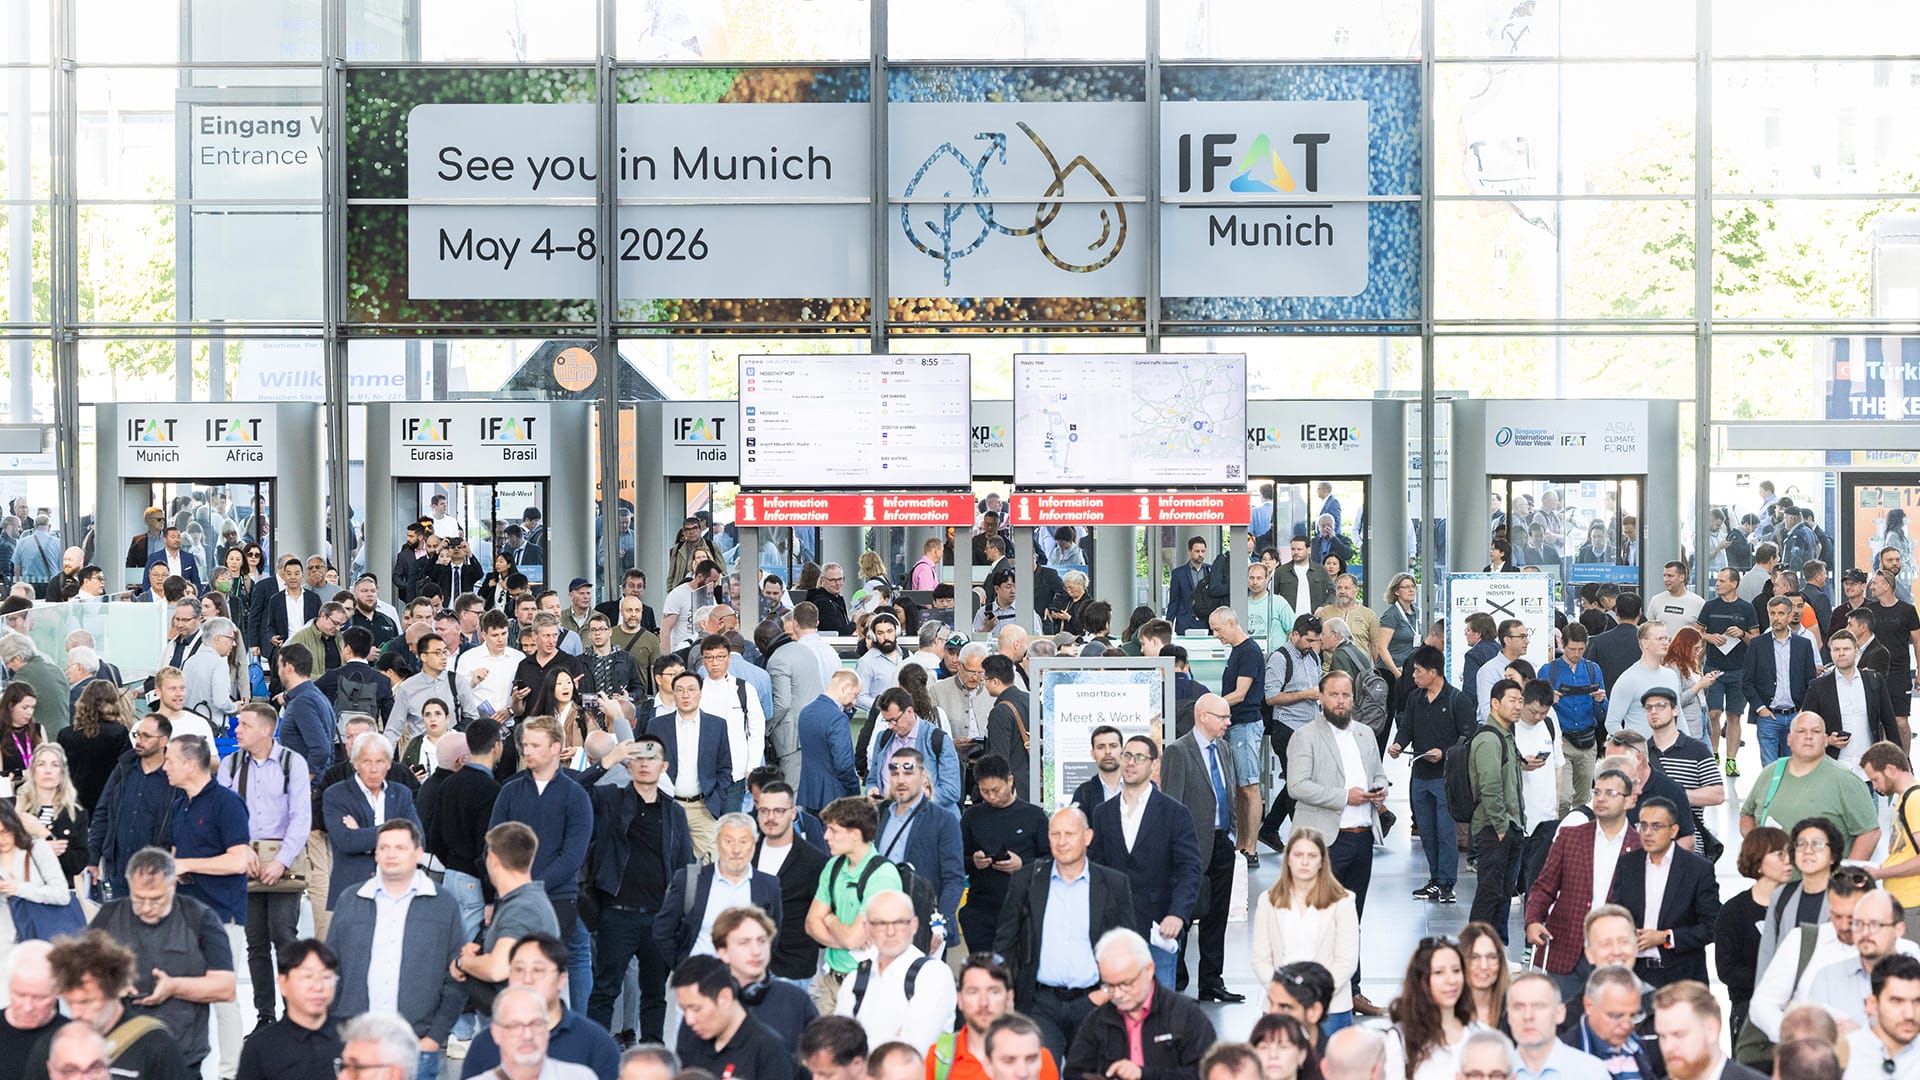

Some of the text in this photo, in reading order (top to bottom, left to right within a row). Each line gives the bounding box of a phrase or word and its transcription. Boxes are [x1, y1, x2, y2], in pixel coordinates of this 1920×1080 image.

[201, 115, 301, 137] Eingang
[201, 146, 308, 165] Entrance
[438, 146, 832, 191] See you in Munich
[1179, 133, 1330, 193] IFAT
[1209, 214, 1334, 246] Munich
[439, 228, 709, 271] May 4–8 2026
[921, 358, 939, 366] 8:55
[258, 370, 432, 387] Willkmme!
[1849, 396, 1887, 415] THE
[128, 418, 178, 442] IFAT
[206, 418, 262, 442] IFAT
[402, 417, 452, 441] IFAT
[480, 416, 536, 440] IFAT
[674, 417, 725, 440] IFAT
[1605, 421, 1635, 433] ASIA
[1561, 435, 1586, 446] IFAT
[136, 450, 179, 461] Munich
[226, 449, 263, 461] Africa
[411, 448, 453, 461] Eurasia
[503, 448, 537, 461] Brasil
[697, 448, 727, 461] India
[763, 497, 828, 508] Information
[884, 497, 948, 508] Information
[1038, 497, 1104, 507] Information
[1158, 497, 1224, 507] Information
[764, 510, 829, 521] Information
[884, 510, 949, 521] Information
[1039, 509, 1104, 521] Information
[1159, 509, 1224, 521] Information
[1456, 597, 1478, 606] IFAT
[1520, 597, 1543, 606] IFAT
[1060, 712, 1142, 723] Meet & Work
